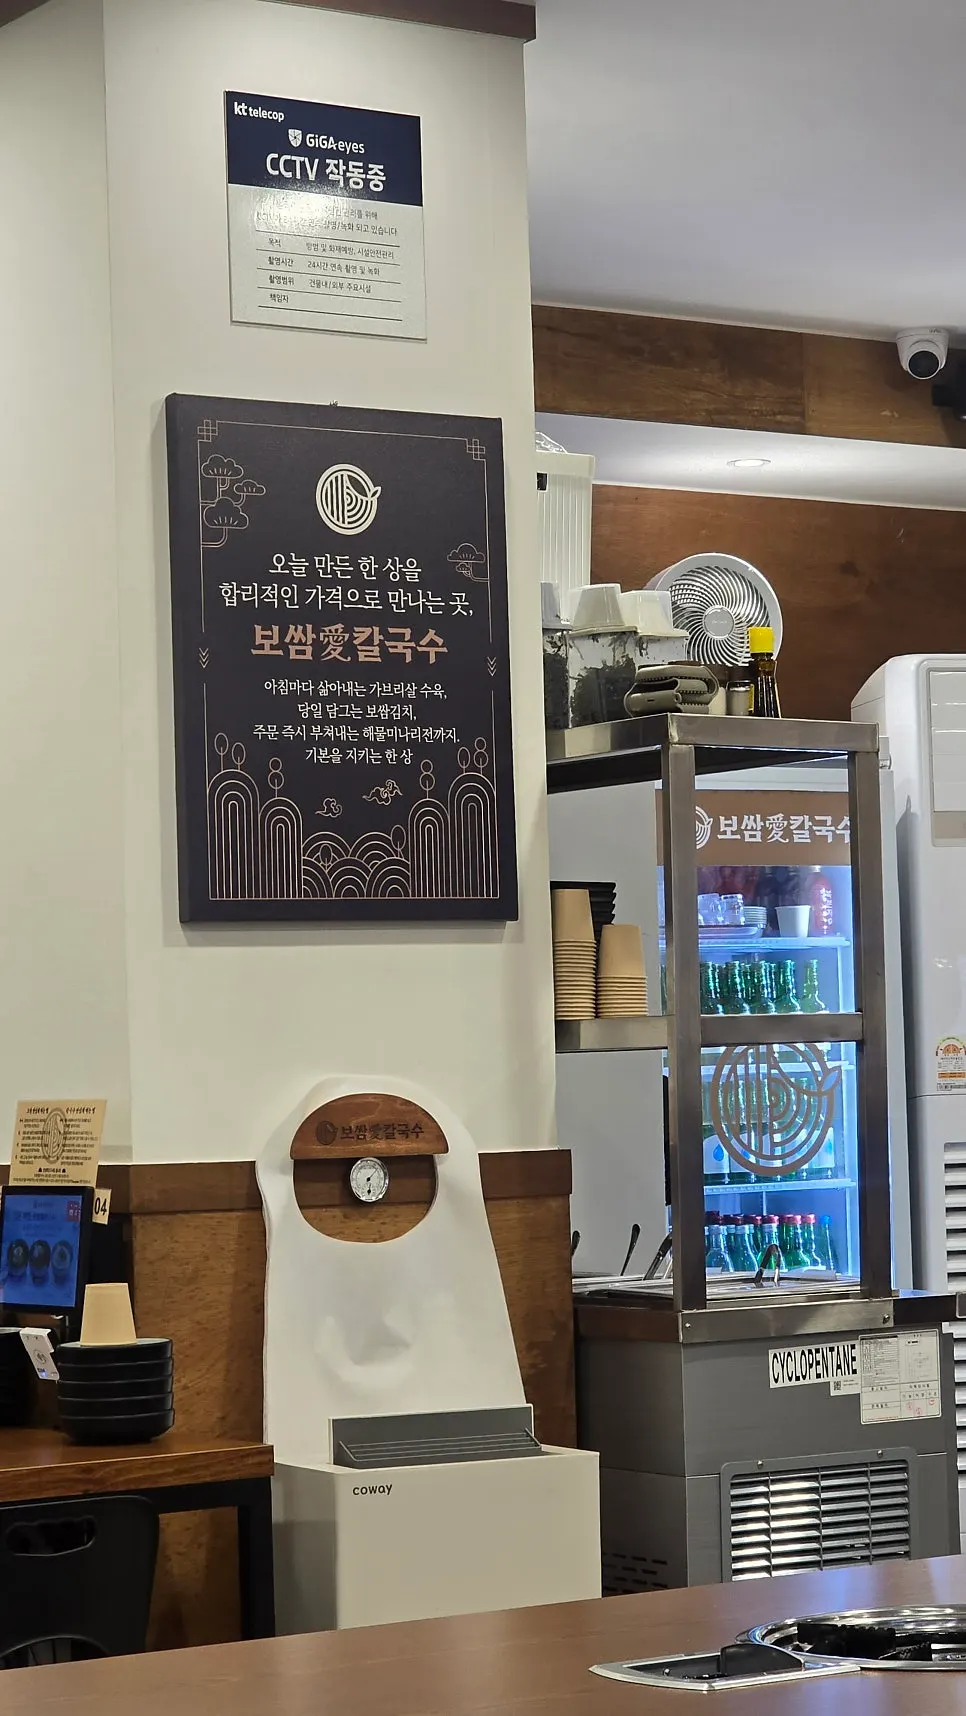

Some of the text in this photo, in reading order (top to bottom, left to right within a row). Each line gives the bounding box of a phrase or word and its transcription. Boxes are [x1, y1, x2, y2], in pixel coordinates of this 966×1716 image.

[234, 102, 285, 123] kt telecop
[266, 153, 386, 192] CCTV 작동중
[365, 210, 378, 220] 위해
[356, 223, 369, 233] 되고
[371, 225, 397, 237] 있습니다
[306, 242, 319, 252] 방범
[320, 244, 328, 252] 및
[357, 247, 394, 259] 시설안전관리
[268, 256, 294, 267] 촬영시간
[307, 261, 380, 276] 24시간 연속 촬영 및 녹화
[268, 274, 294, 286] 촬영범위
[309, 278, 371, 294] 건물내/외부 주요시설
[269, 293, 289, 303] 책임자
[269, 552, 422, 582] 오늘 만든 한 상을
[218, 581, 474, 617] 합리적인 가격으로 만나는 곳,
[251, 622, 448, 664] 보쌈愛칼국수
[264, 678, 448, 700] 아침마다 삶아내는 가브리살 수육,
[297, 702, 417, 721] 당일 담그는 보쌈김치,
[253, 724, 460, 744] 주문 즉시 부쳐내는 해물미나리전까지.
[305, 747, 413, 765] 기본을 지키는 한 상
[94, 1197, 107, 1216] 04
[771, 1343, 857, 1384] CYCLOPENTANE
[352, 1484, 393, 1496] coway
